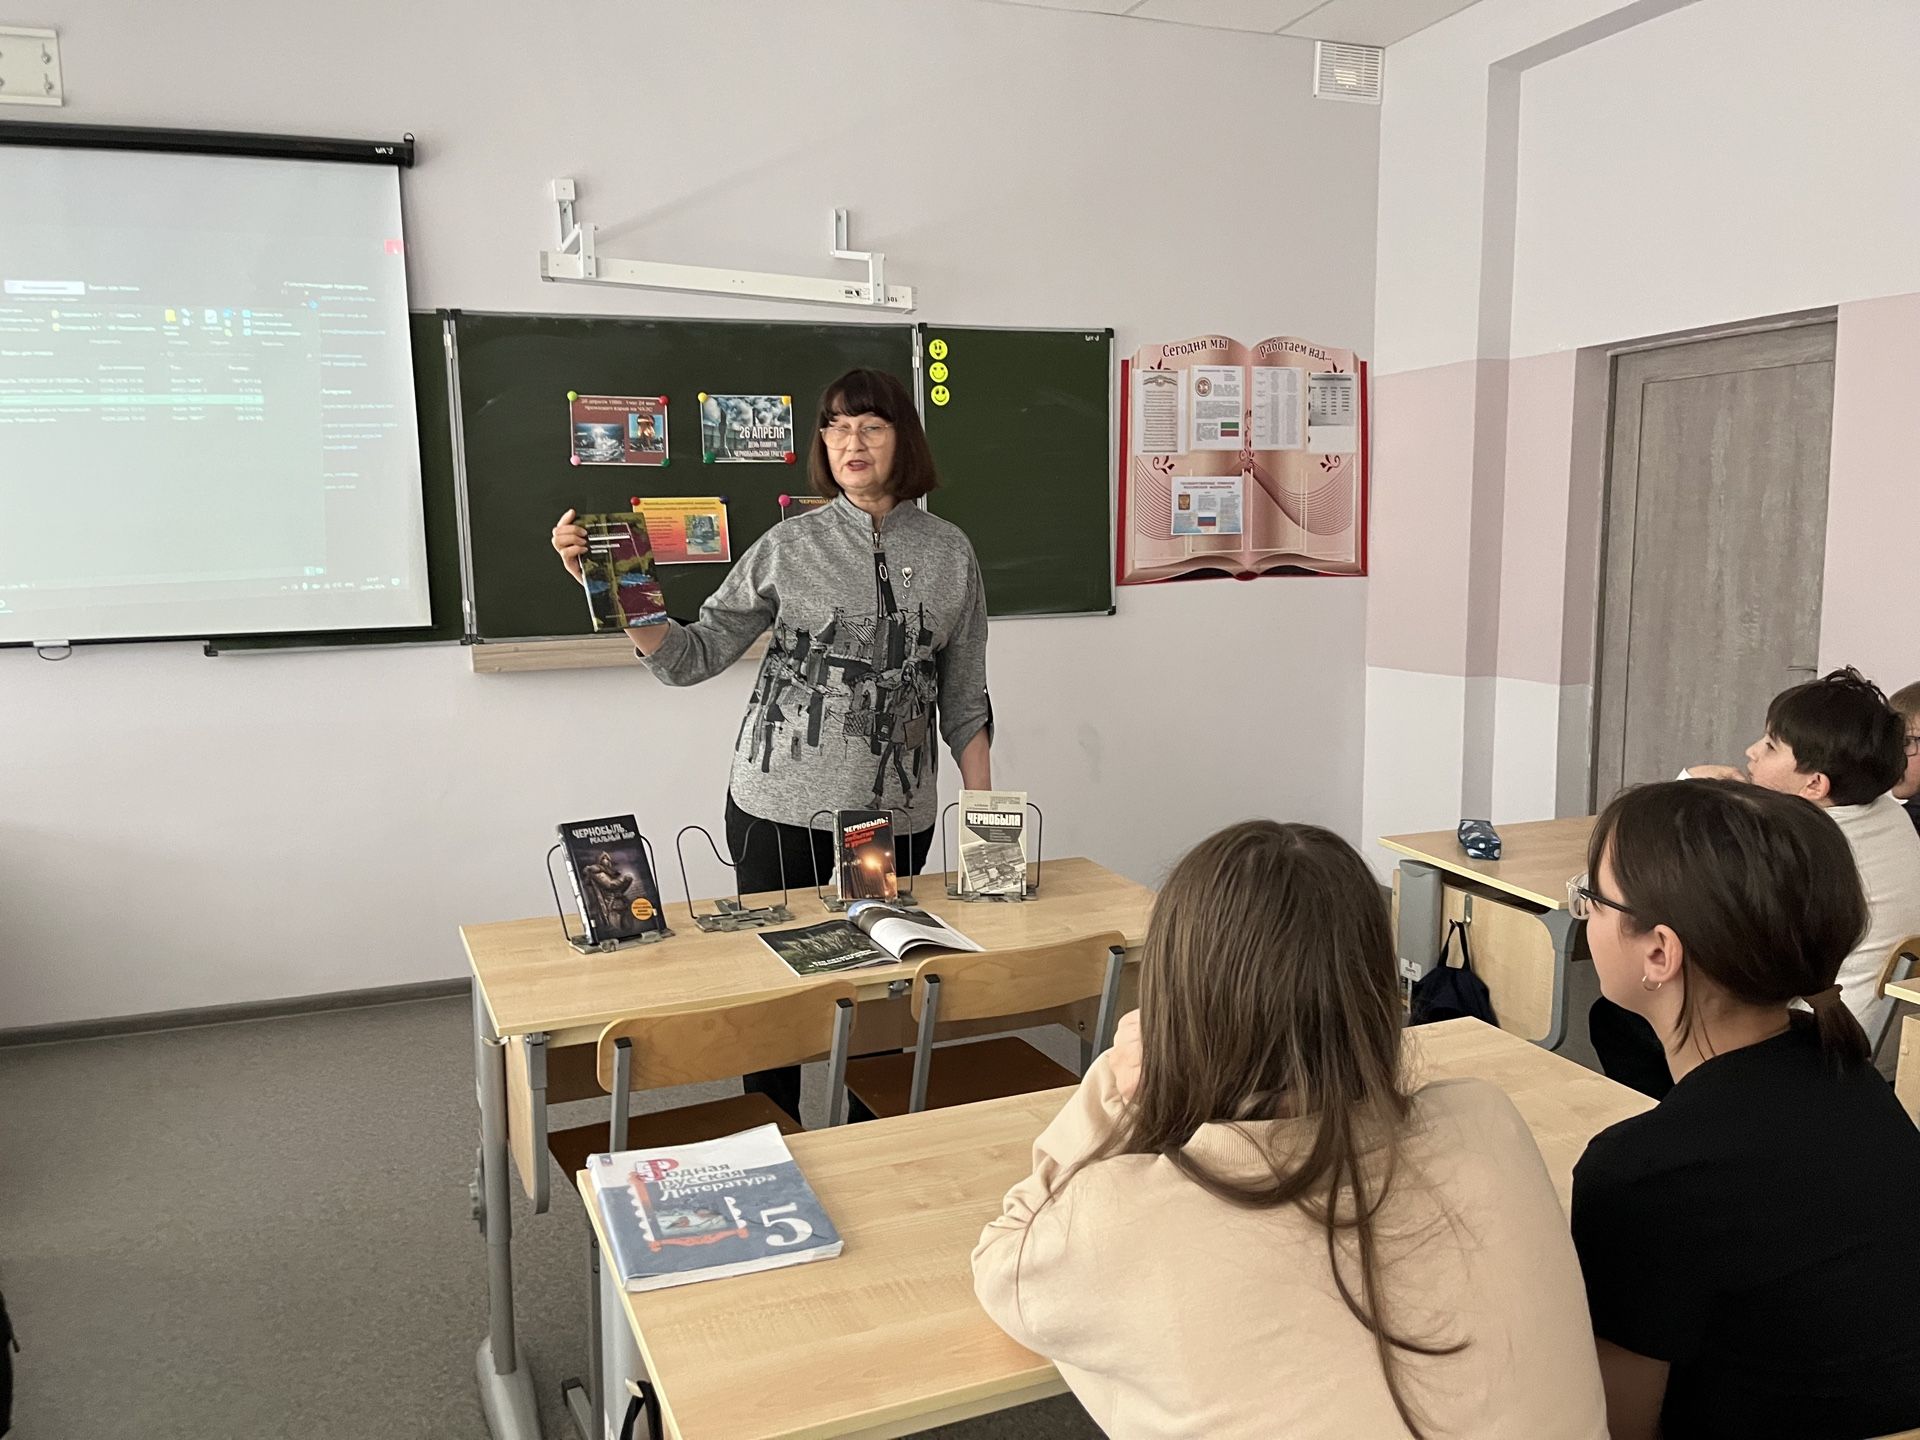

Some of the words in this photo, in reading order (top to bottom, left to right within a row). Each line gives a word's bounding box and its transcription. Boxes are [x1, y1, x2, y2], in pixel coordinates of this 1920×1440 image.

[1162, 340, 1207, 358] Сегодня
[1210, 339, 1228, 350] мы
[1259, 340, 1307, 358] работаем
[1308, 346, 1332, 361] над...
[739, 426, 750, 439] 26
[752, 426, 785, 439] АПРЕЛЯ
[843, 816, 889, 833] ЧЕРНОБЫЛЬ:
[967, 812, 1021, 826] ЧЕРНОБЫЛЯ
[622, 831, 635, 840] МИР
[636, 1158, 730, 1181] Родная
[660, 1169, 743, 1191] русская
[660, 1174, 777, 1201] Литература
[760, 1202, 813, 1247] 5
